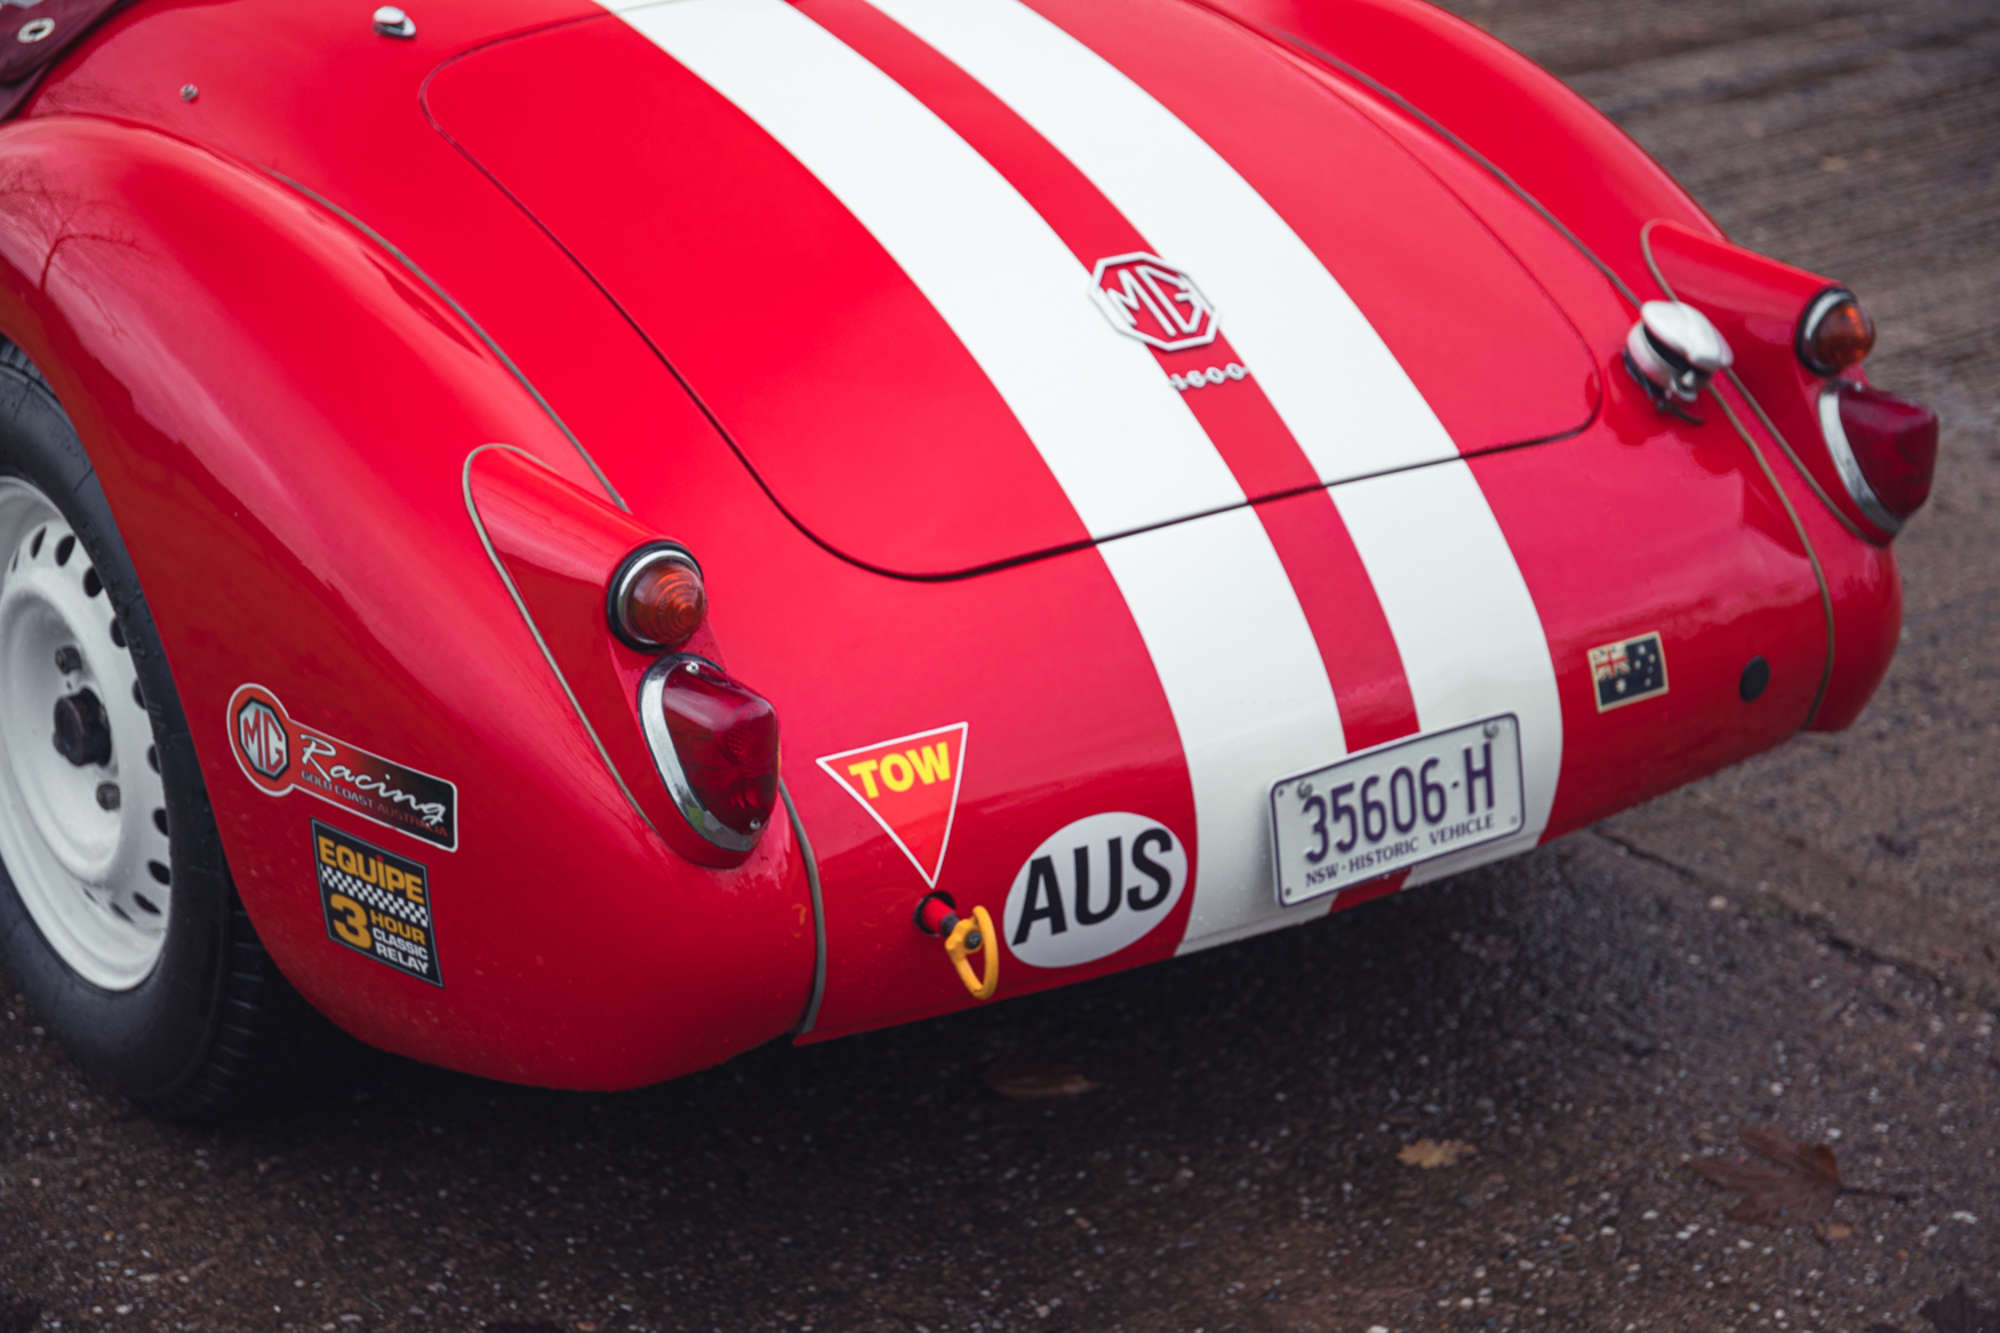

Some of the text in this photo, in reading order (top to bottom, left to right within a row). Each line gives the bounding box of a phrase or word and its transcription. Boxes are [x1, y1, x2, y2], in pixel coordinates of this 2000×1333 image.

[1106, 264, 1205, 338] MG
[241, 701, 288, 776] MG
[300, 733, 446, 827] Racing
[301, 769, 332, 792] GOLD
[334, 784, 375, 809] COAST
[848, 741, 952, 799] TOW
[1429, 813, 1495, 846] VEHICLE
[1011, 827, 1174, 947] AUS
[330, 893, 372, 950] 3
[369, 908, 426, 946] HOUR
[372, 926, 429, 960] CLASSIC
[375, 942, 429, 974] RELAY
